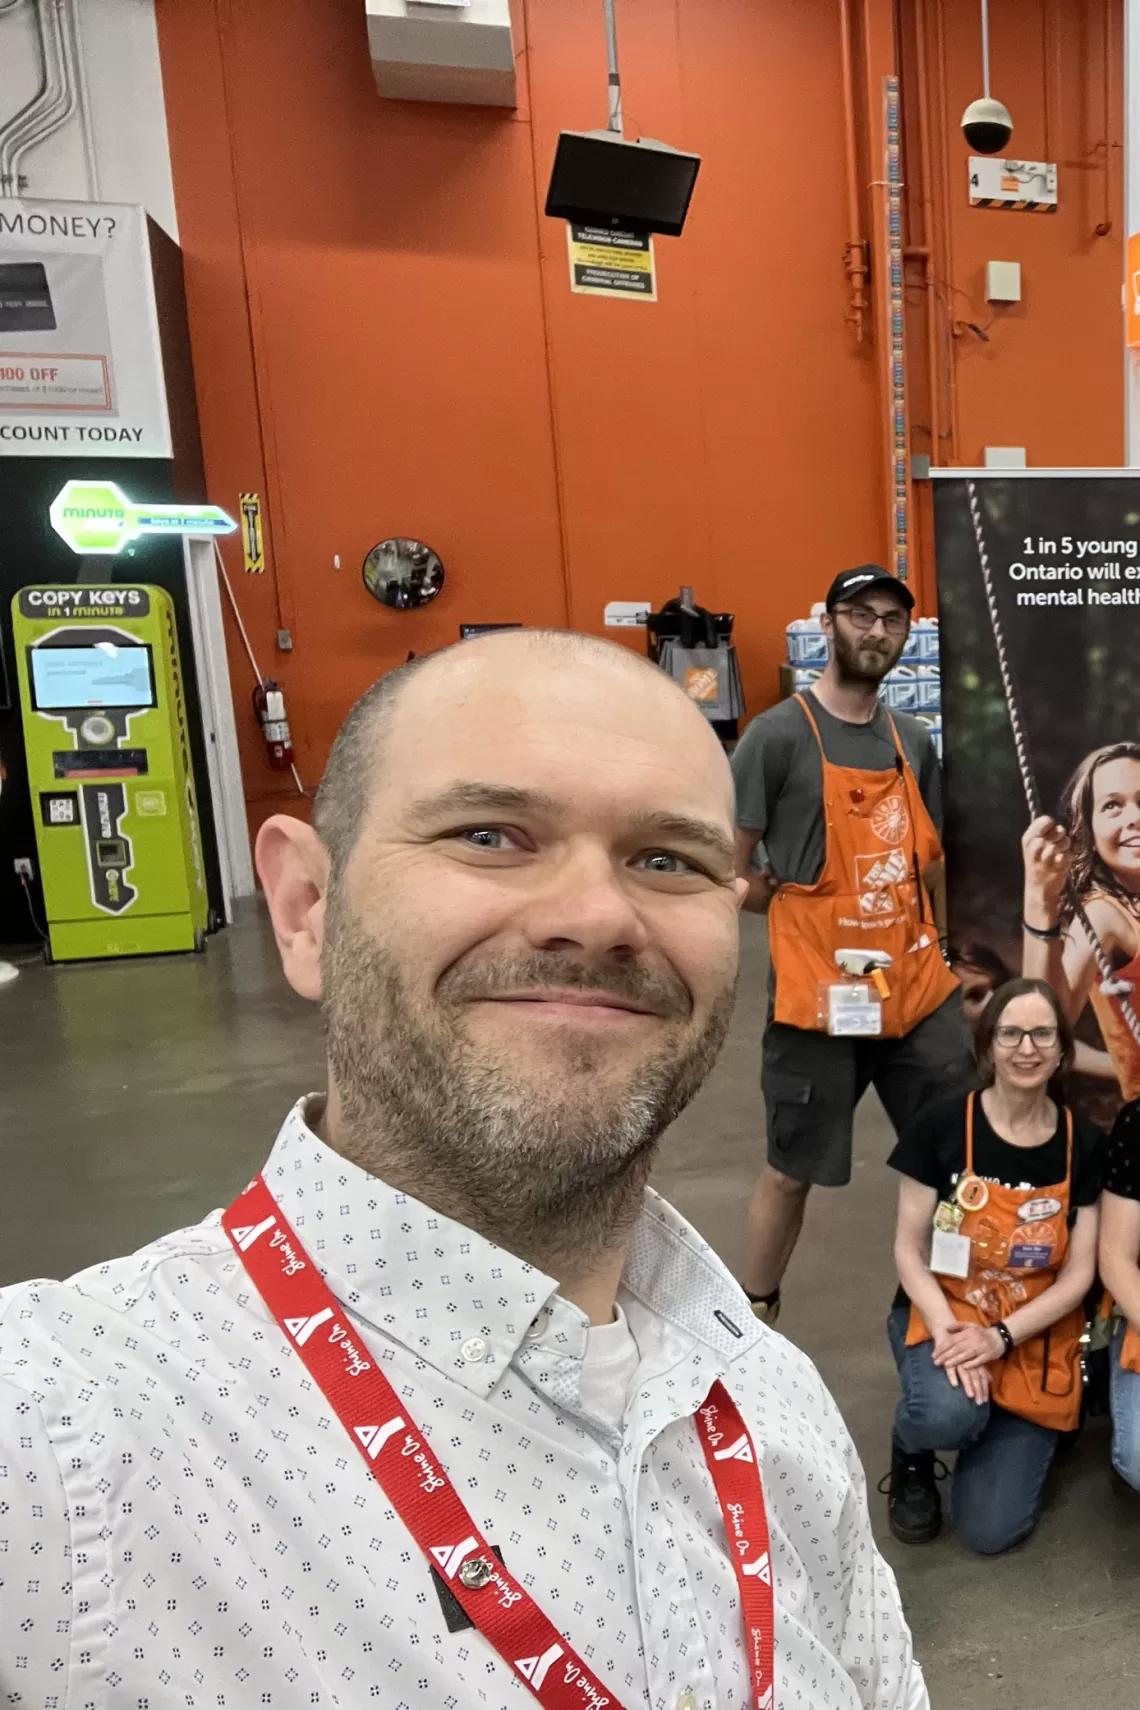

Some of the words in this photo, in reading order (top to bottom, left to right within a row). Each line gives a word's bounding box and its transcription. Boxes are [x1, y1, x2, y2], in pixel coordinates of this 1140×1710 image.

[0, 212, 116, 239] MONEY?
[30, 368, 59, 382] OFF
[0, 425, 69, 440] COUNT
[76, 426, 143, 442] TODAY
[1023, 537, 1034, 554] 1
[1038, 537, 1057, 554] in
[1061, 537, 1073, 554] 5
[1076, 540, 1138, 558] young
[1009, 562, 1083, 581] Ontario
[1086, 562, 1121, 580] will
[28, 590, 83, 605] COPY
[1017, 588, 1084, 606] mental
[64, 606, 70, 617] 1
[268, 1229, 288, 1248] On
[279, 1239, 306, 1276] Shine
[328, 1323, 347, 1343] On
[340, 1338, 371, 1377] Shine
[699, 1404, 718, 1433] Shine
[400, 1434, 421, 1456] On
[707, 1433, 725, 1447] On
[414, 1454, 446, 1494] Shine
[726, 1502, 745, 1538] Shine
[735, 1540, 750, 1557] On
[490, 1573, 523, 1609] Shine
[563, 1660, 581, 1684] On
[576, 1676, 610, 1710] Shine
